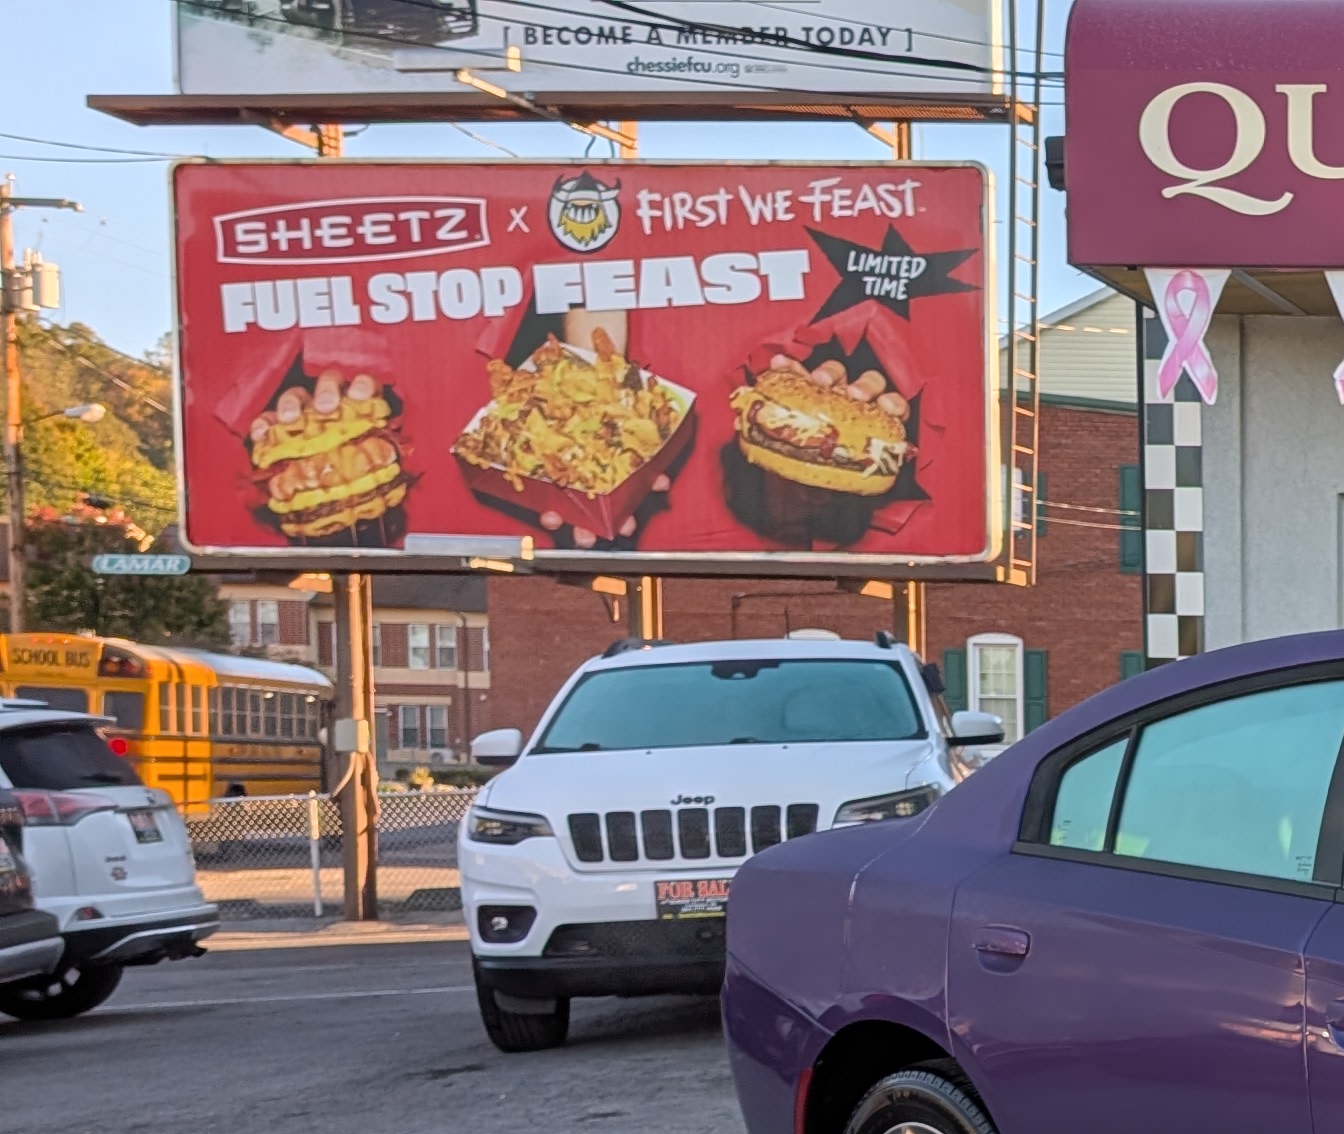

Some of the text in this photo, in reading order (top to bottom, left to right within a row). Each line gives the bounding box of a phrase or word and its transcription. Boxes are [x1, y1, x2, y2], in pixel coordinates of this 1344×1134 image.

[523, 26, 633, 46] BECOME
[646, 26, 664, 46] A
[801, 26, 892, 47] TODAY
[626, 55, 741, 79] chessiefcu.org
[234, 207, 469, 254] SHEETZ
[635, 187, 733, 235] FIRST
[738, 185, 797, 226] WE
[799, 177, 922, 223] FEAST
[846, 249, 927, 278] LIMITED
[220, 250, 810, 333] FUEL STOP FEAST
[862, 276, 909, 300] TIME
[101, 556, 180, 572] LAMAR
[12, 647, 91, 668] SCHOOL BUS
[670, 795, 715, 806] Jeep
[697, 880, 730, 898] SAL
